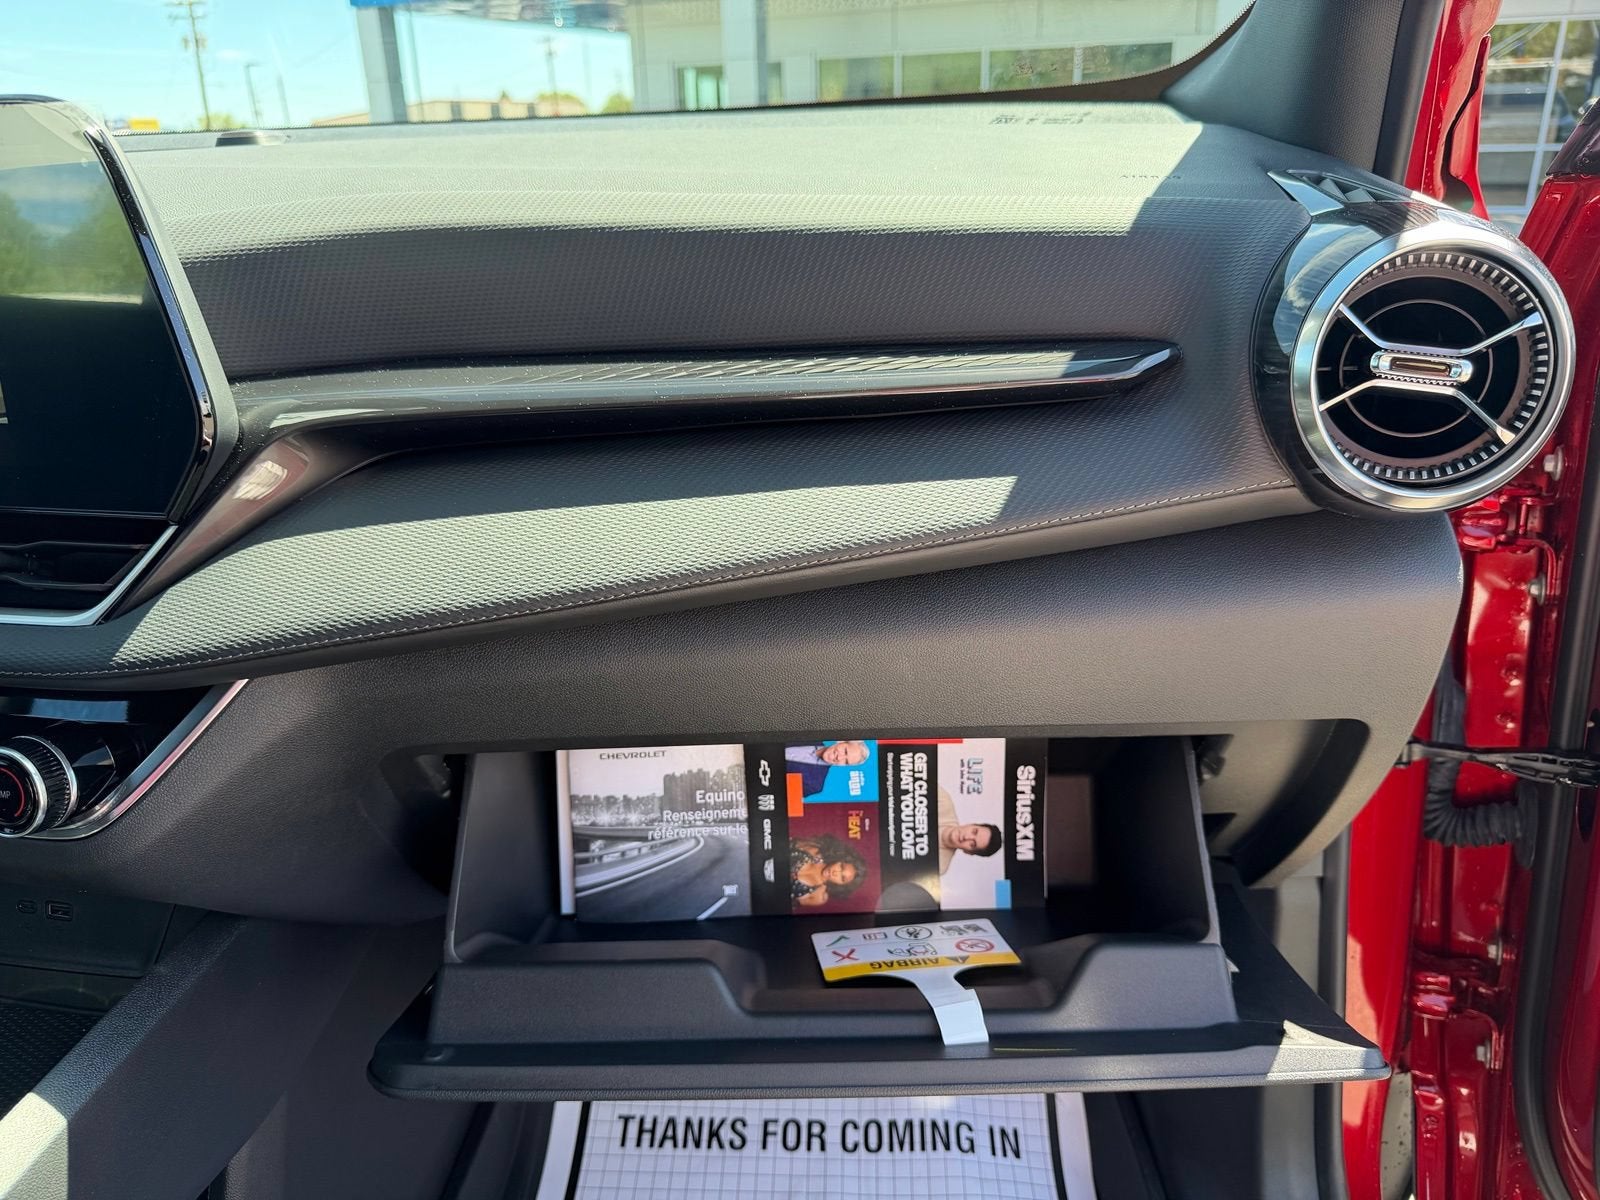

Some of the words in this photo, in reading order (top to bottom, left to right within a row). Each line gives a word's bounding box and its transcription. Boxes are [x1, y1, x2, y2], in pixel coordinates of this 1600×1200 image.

[599, 750, 667, 760] CHEVROLET
[914, 752, 928, 780] GET
[900, 752, 913, 791] WHAT
[966, 758, 983, 794] LIFE
[695, 789, 745, 805] Equino
[901, 792, 914, 821] YOU
[914, 781, 928, 834] CLOSER
[848, 810, 861, 839] HEAT
[1016, 765, 1036, 861] SiriusXM
[647, 823, 709, 840] référence
[712, 825, 732, 836] sur
[763, 818, 772, 850] GMC
[901, 822, 915, 860] LOVE
[915, 835, 929, 856] TO
[869, 956, 940, 970] AIRBAG
[618, 1115, 747, 1151] THANKS
[762, 1118, 827, 1152] FOR
[841, 1118, 976, 1154] COMING
[988, 1124, 1021, 1159] IN
